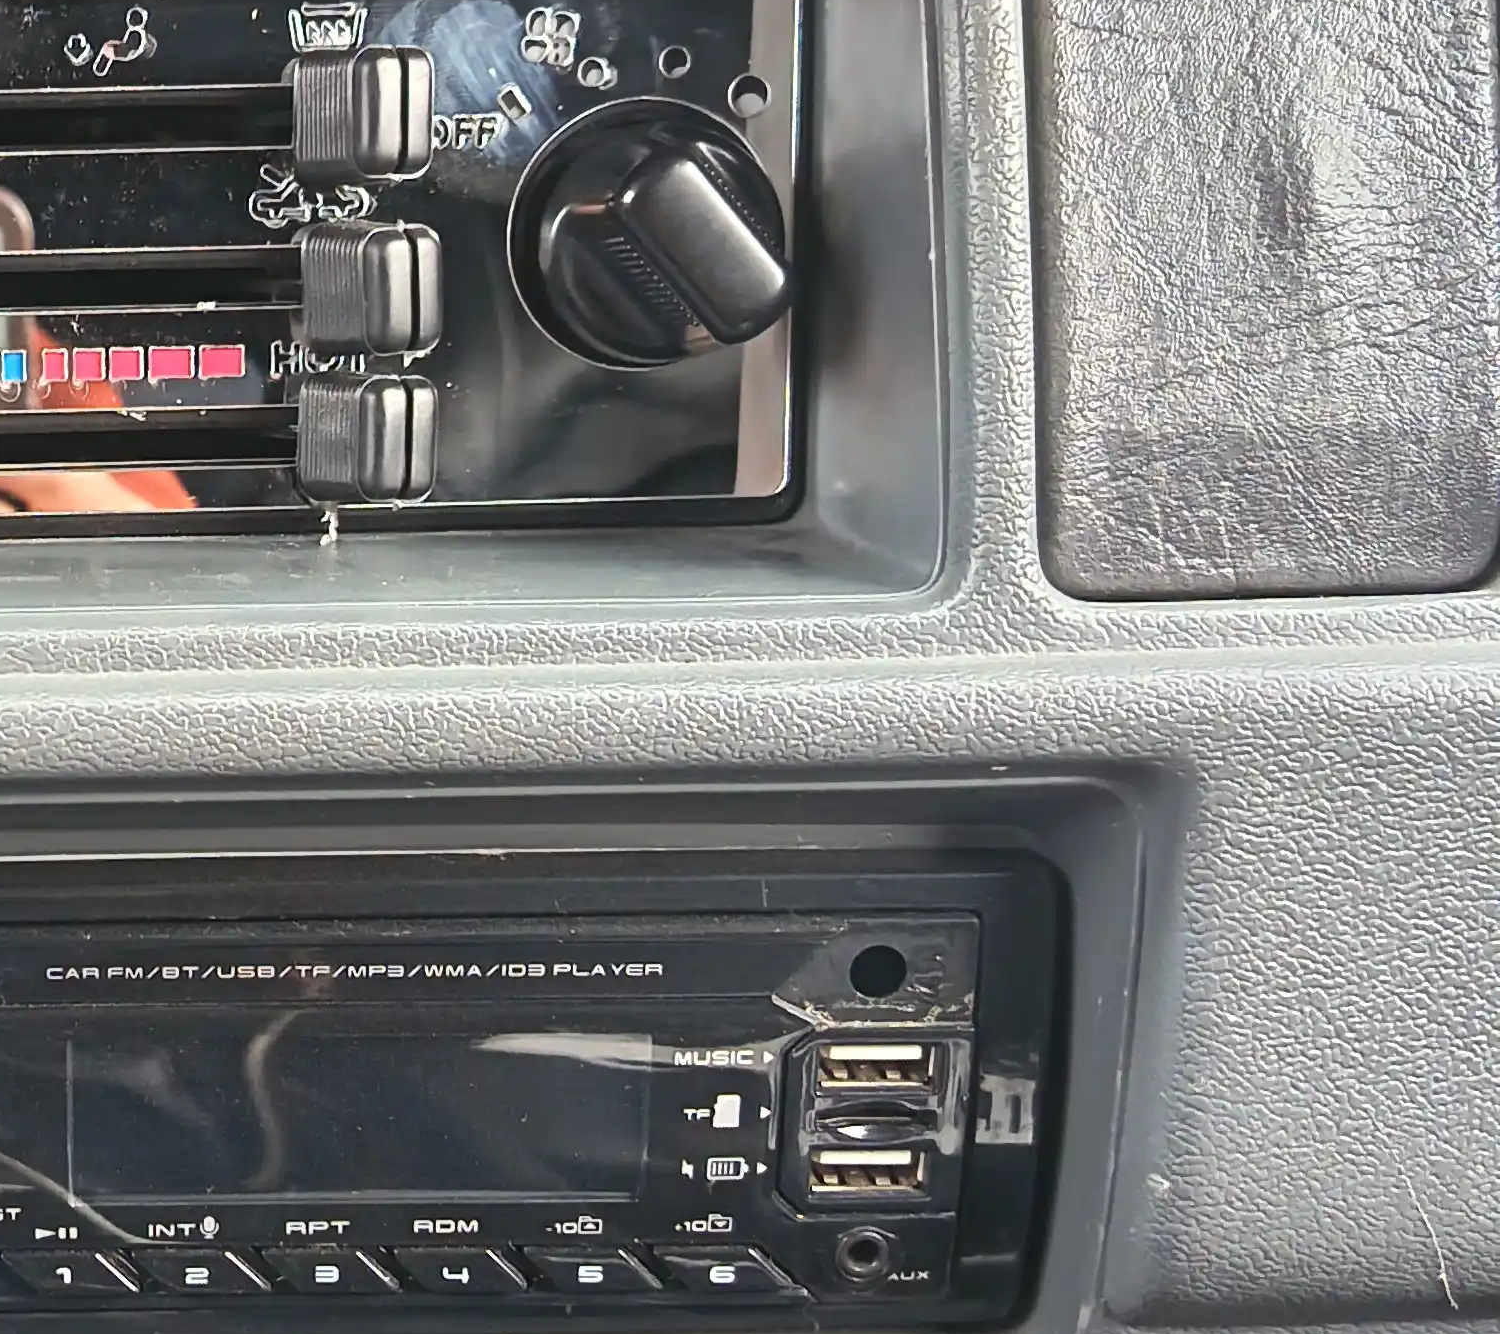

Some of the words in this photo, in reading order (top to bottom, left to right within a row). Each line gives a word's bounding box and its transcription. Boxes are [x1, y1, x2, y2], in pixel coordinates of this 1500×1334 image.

[432, 113, 504, 150] OFF
[46, 966, 100, 980] CAR
[552, 962, 664, 977] PLAYER
[674, 1050, 754, 1066] MUSIC
[683, 1108, 711, 1121] TF
[146, 1223, 197, 1238] INT
[285, 1220, 351, 1236] RPT
[55, 1266, 73, 1284] 1
[184, 1267, 210, 1285] 2
[314, 1265, 340, 1283] 3
[442, 1266, 470, 1284] 4
[577, 1265, 604, 1284] 5
[708, 1265, 736, 1284] 6
[887, 1270, 930, 1281] AUX
